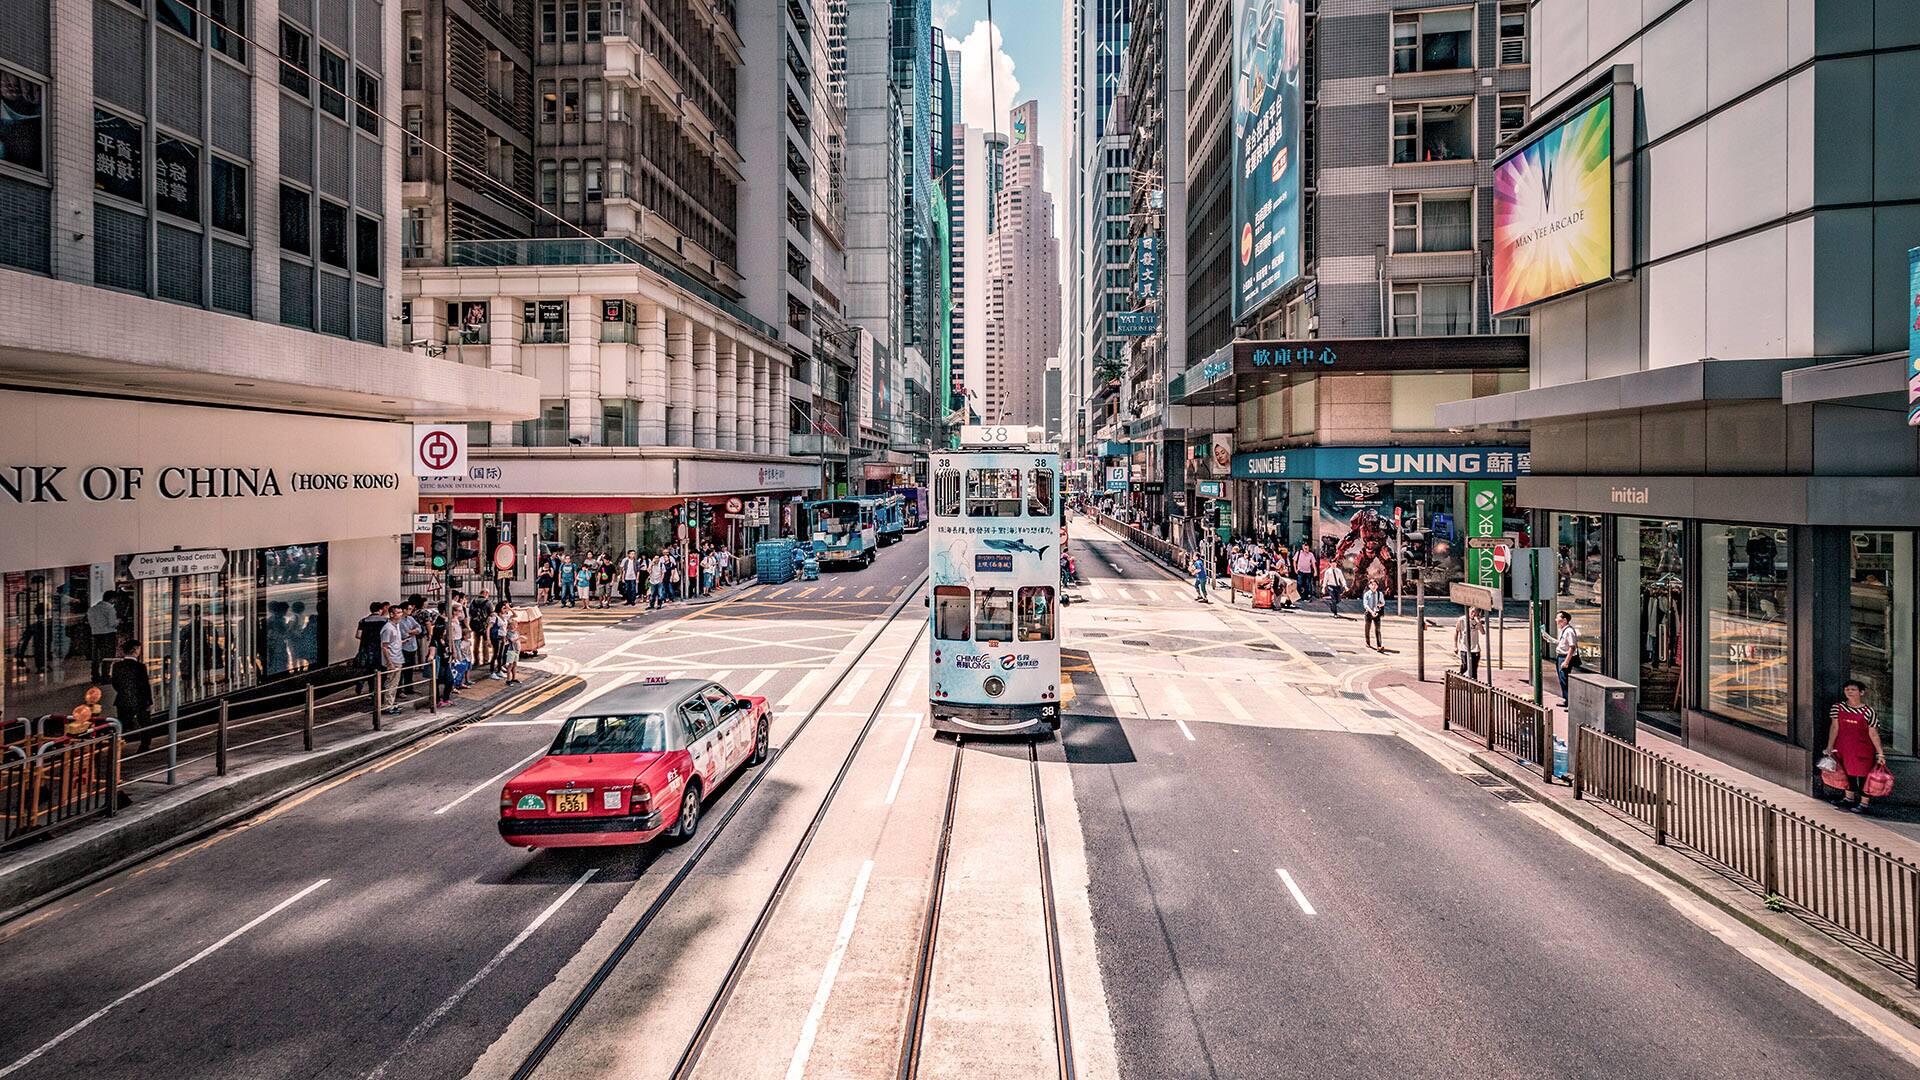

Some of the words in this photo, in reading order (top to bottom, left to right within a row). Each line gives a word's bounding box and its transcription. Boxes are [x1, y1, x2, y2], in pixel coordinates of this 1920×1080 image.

[1515, 232, 1533, 249] MAN
[1533, 226, 1548, 240] YEE
[1549, 209, 1585, 235] ARCADE
[1140, 238, 1155, 298] 日發文具
[1120, 315, 1137, 324] YAT
[1140, 315, 1155, 324] FAT
[934, 340, 942, 369] FUR
[1253, 346, 1337, 367] 軟庫中心
[981, 427, 1009, 442] 38
[938, 458, 951, 468] 38
[1034, 458, 1047, 468] 38
[1248, 457, 1273, 474] SUNING
[1358, 453, 1480, 473] SUNING
[82, 465, 144, 501] OF
[158, 466, 283, 499] CHINA
[291, 472, 348, 492] (HONG
[352, 472, 400, 491] KONG)
[1354, 493, 1364, 501] 2
[1611, 487, 1649, 504] initial
[140, 557, 154, 565] Des
[155, 555, 175, 564] Voeux
[176, 554, 193, 562] Road
[194, 552, 217, 561] Central
[955, 654, 981, 662] CHIME
[645, 676, 665, 684] TAXI
[1042, 706, 1054, 717] 38
[565, 794, 578, 803] EZ
[559, 802, 584, 812] 6361
